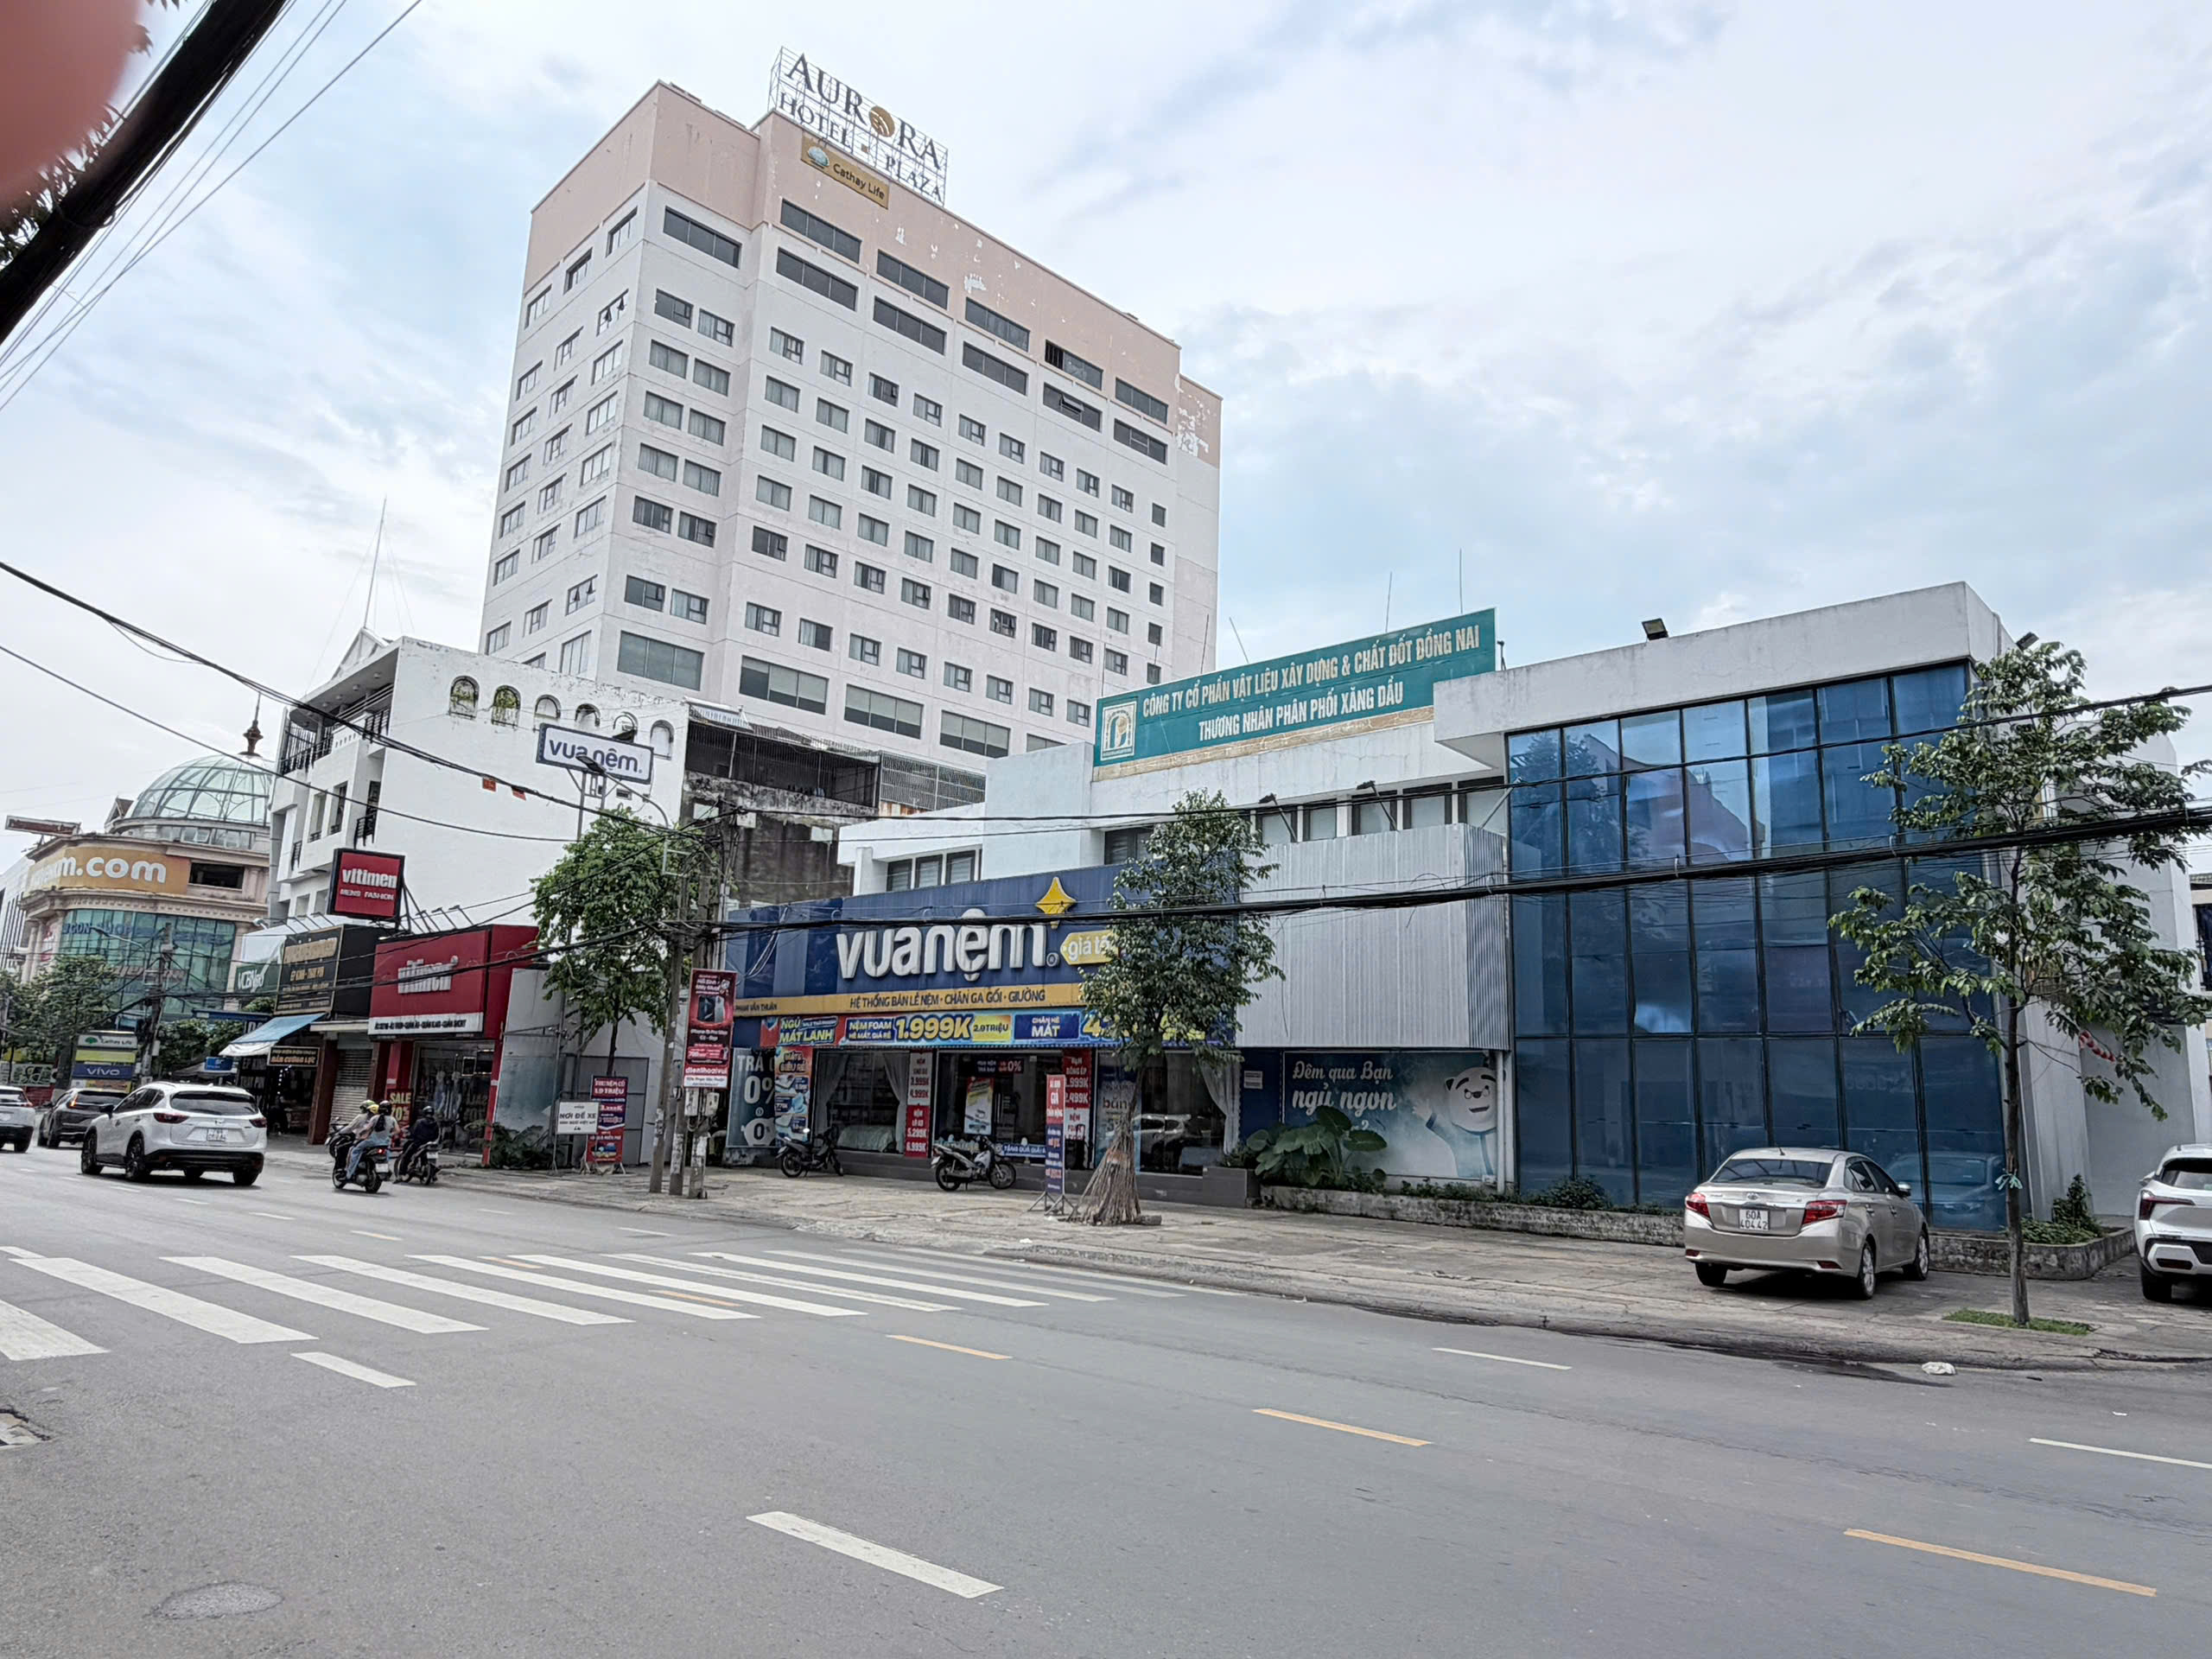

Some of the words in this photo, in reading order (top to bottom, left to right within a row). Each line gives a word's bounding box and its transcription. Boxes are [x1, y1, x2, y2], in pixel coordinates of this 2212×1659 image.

[784, 53, 941, 170] AURORA
[780, 92, 853, 149] HOTEL
[886, 156, 943, 202] PLAZA
[833, 163, 867, 190] Cathay
[868, 181, 885, 200] Life
[1143, 693, 1169, 717] CÔNG
[1173, 691, 1183, 710] TY
[1185, 679, 1200, 709] CỔ
[1202, 675, 1230, 705] PHẦN
[1233, 673, 1252, 702] VẬT
[1255, 668, 1278, 696] LIỆU
[1281, 662, 1303, 689] XÂY
[1306, 657, 1338, 687] DỰNG
[1342, 655, 1351, 676] &
[1354, 639, 1385, 674] CHẤT
[1389, 633, 1413, 666] ĐỐT
[1416, 627, 1452, 661] ĐỒNG
[1455, 625, 1479, 652] NAI
[1198, 714, 1240, 741] THƯƠNG
[1243, 705, 1273, 733] NHÂN
[1276, 698, 1306, 727] PHÂN
[1310, 688, 1338, 721] PHỐI
[1341, 687, 1374, 715] XĂNG
[1377, 676, 1403, 707] DẦU
[1069, 938, 1092, 962] giá
[850, 996, 861, 1009] HỆ
[862, 994, 889, 1007] THỐNG
[892, 992, 908, 1007] BÁN
[910, 993, 920, 1006] LẺ
[921, 993, 939, 1007] NỆM
[970, 991, 984, 1003] GA
[986, 988, 1002, 1002] GỐI
[1009, 988, 1046, 1002] GIƯỜNG
[781, 1017, 800, 1029] NGỦ
[868, 1020, 892, 1030] FOAM
[896, 1015, 972, 1040] 1.999K
[1032, 1021, 1060, 1037] MÁT
[779, 1029, 803, 1044] MÁT
[86, 1067, 120, 1076] vivo
[1007, 1060, 1021, 1071] 0%
[1293, 1061, 1325, 1079] Đêm
[1329, 1068, 1357, 1084] qua
[1360, 1061, 1393, 1084] Bạn
[390, 1092, 411, 1104] SALE
[1293, 1082, 1334, 1116] ngủ
[1340, 1091, 1396, 1117] ngon
[1745, 1210, 1762, 1220] 60A
